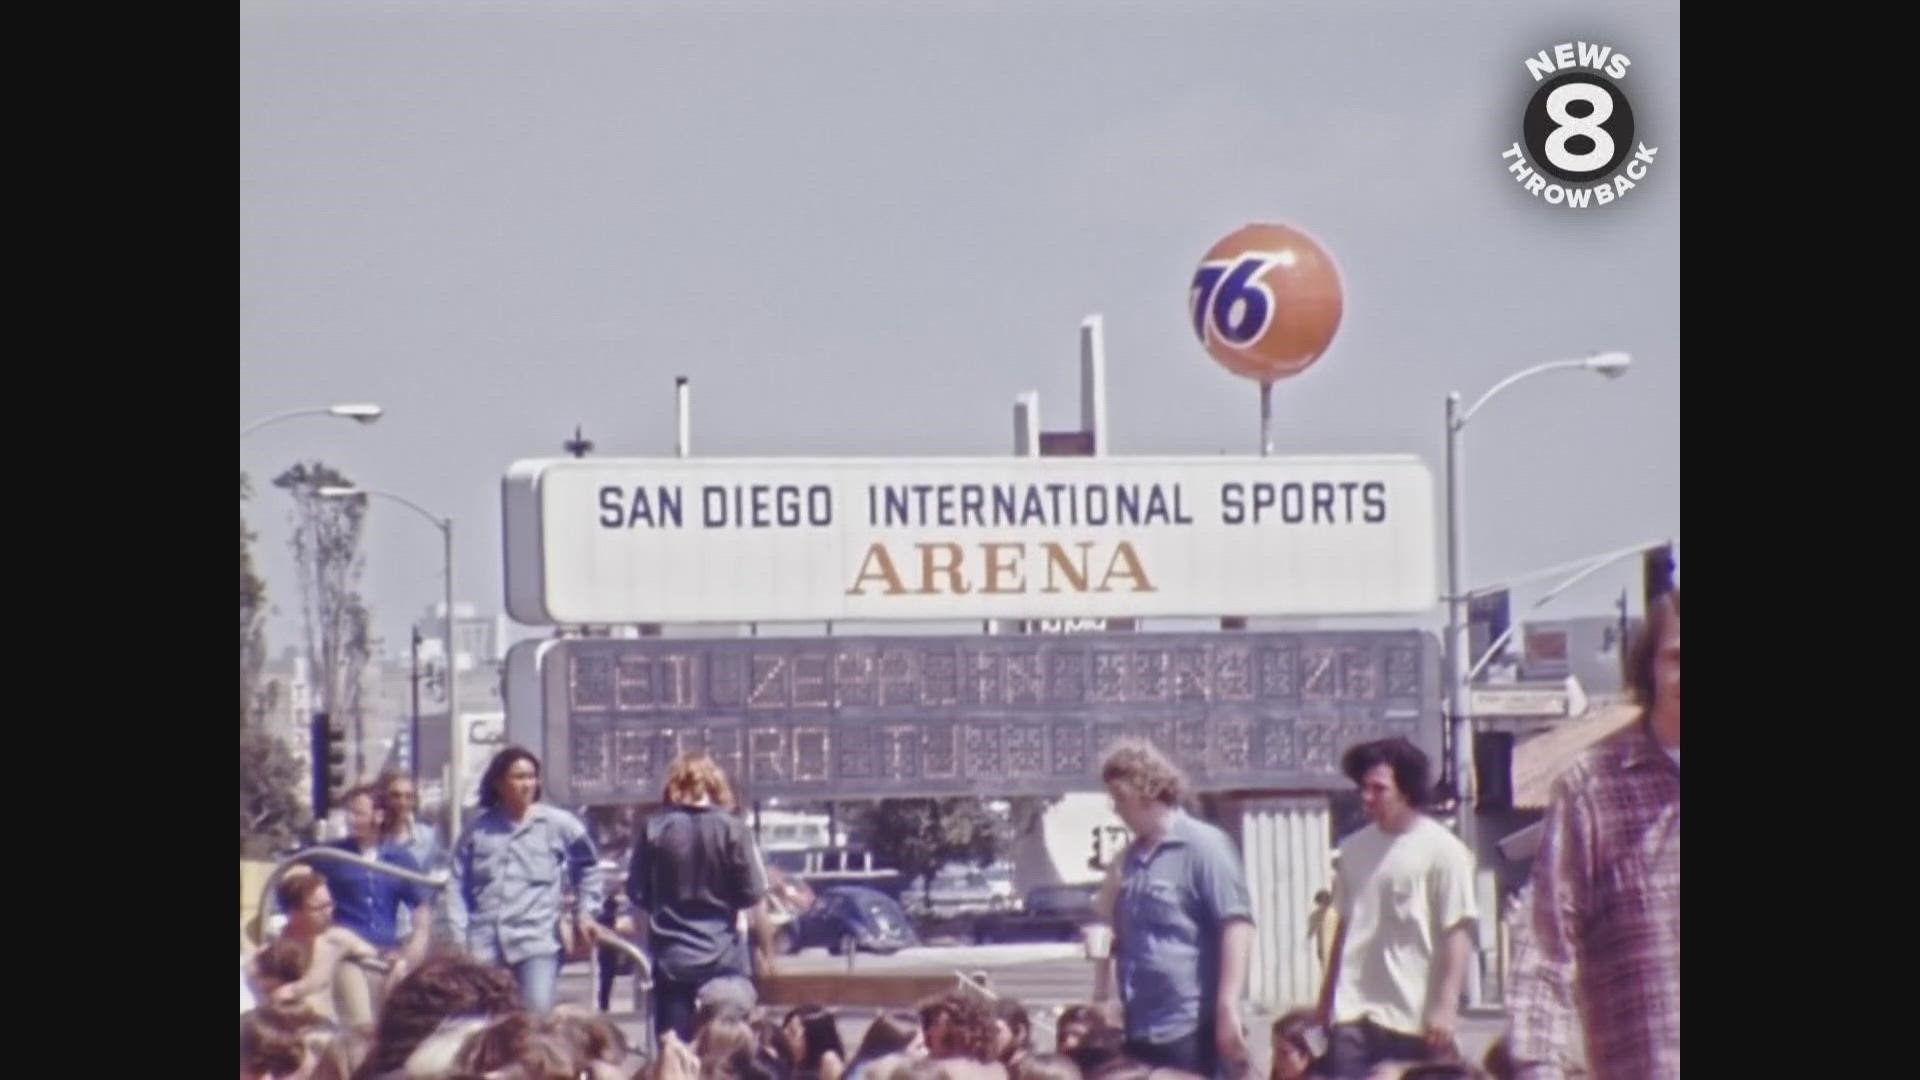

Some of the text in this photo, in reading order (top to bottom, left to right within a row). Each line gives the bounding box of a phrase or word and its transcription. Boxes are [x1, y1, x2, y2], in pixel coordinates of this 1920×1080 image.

[1191, 251, 1285, 349] 76
[599, 482, 1387, 529] SAN DIEGO INTERNATIONAL SPORTS
[845, 540, 1158, 597] ARENA
[569, 655, 697, 711] LED
